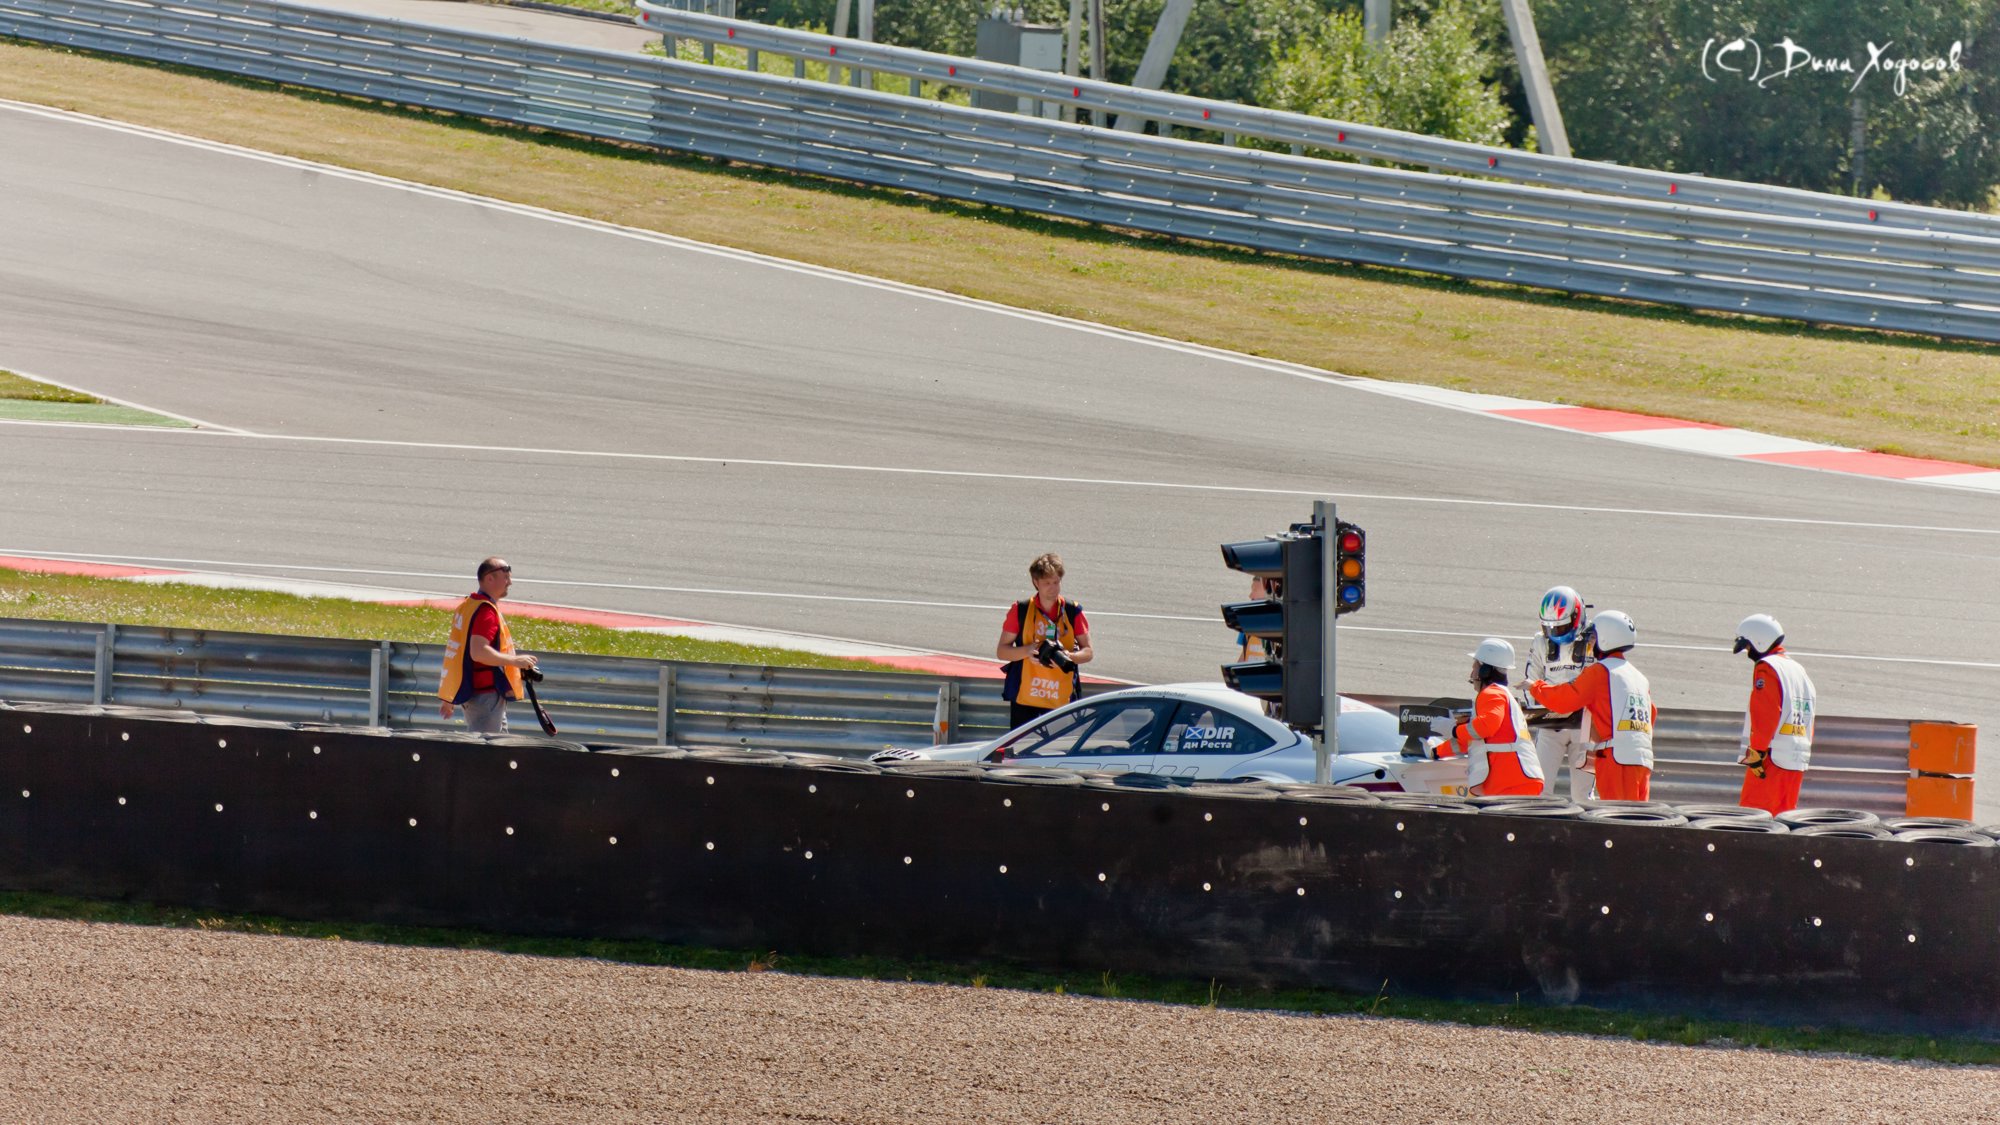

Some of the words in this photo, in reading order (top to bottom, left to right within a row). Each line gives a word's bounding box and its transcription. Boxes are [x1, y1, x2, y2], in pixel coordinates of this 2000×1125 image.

[1031, 677, 1060, 690] DTM
[1029, 687, 1059, 700] 2014
[1203, 726, 1236, 740] DIR
[1200, 740, 1233, 749] Реста
